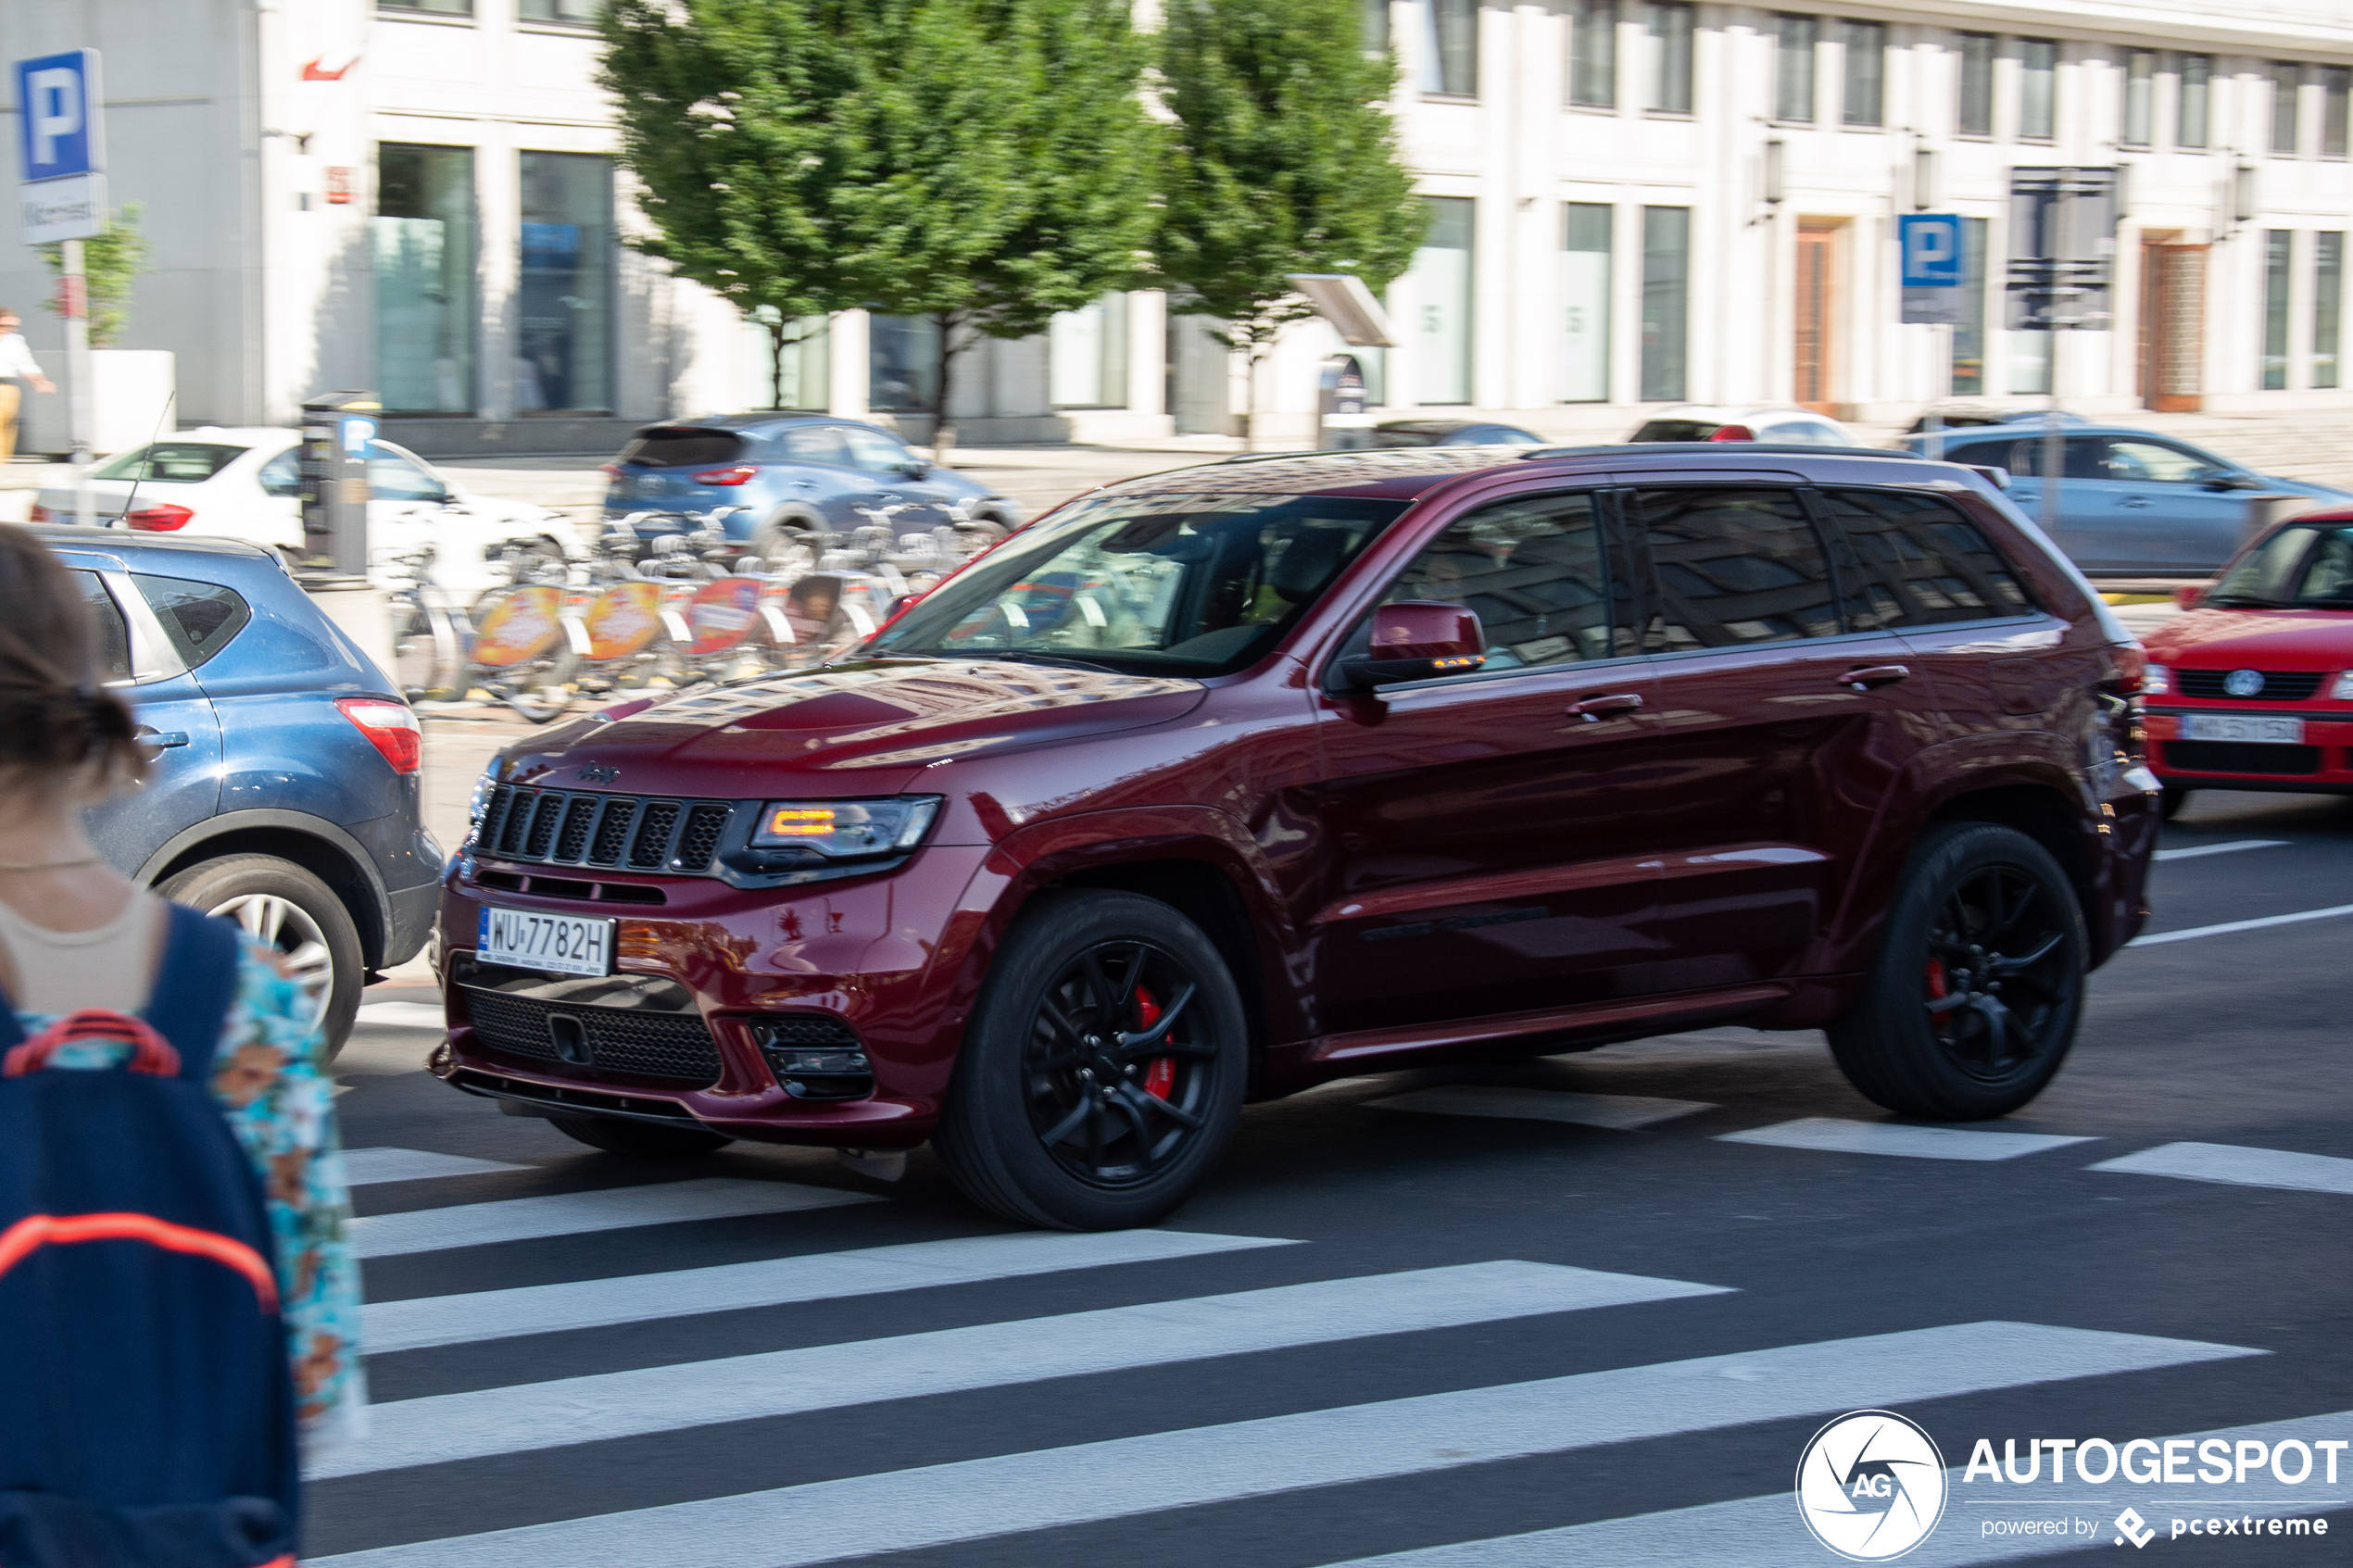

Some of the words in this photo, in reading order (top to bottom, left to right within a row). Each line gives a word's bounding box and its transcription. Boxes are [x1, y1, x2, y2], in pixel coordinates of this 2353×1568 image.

[27, 68, 83, 165] P
[1905, 221, 1953, 278] P
[344, 420, 375, 451] P
